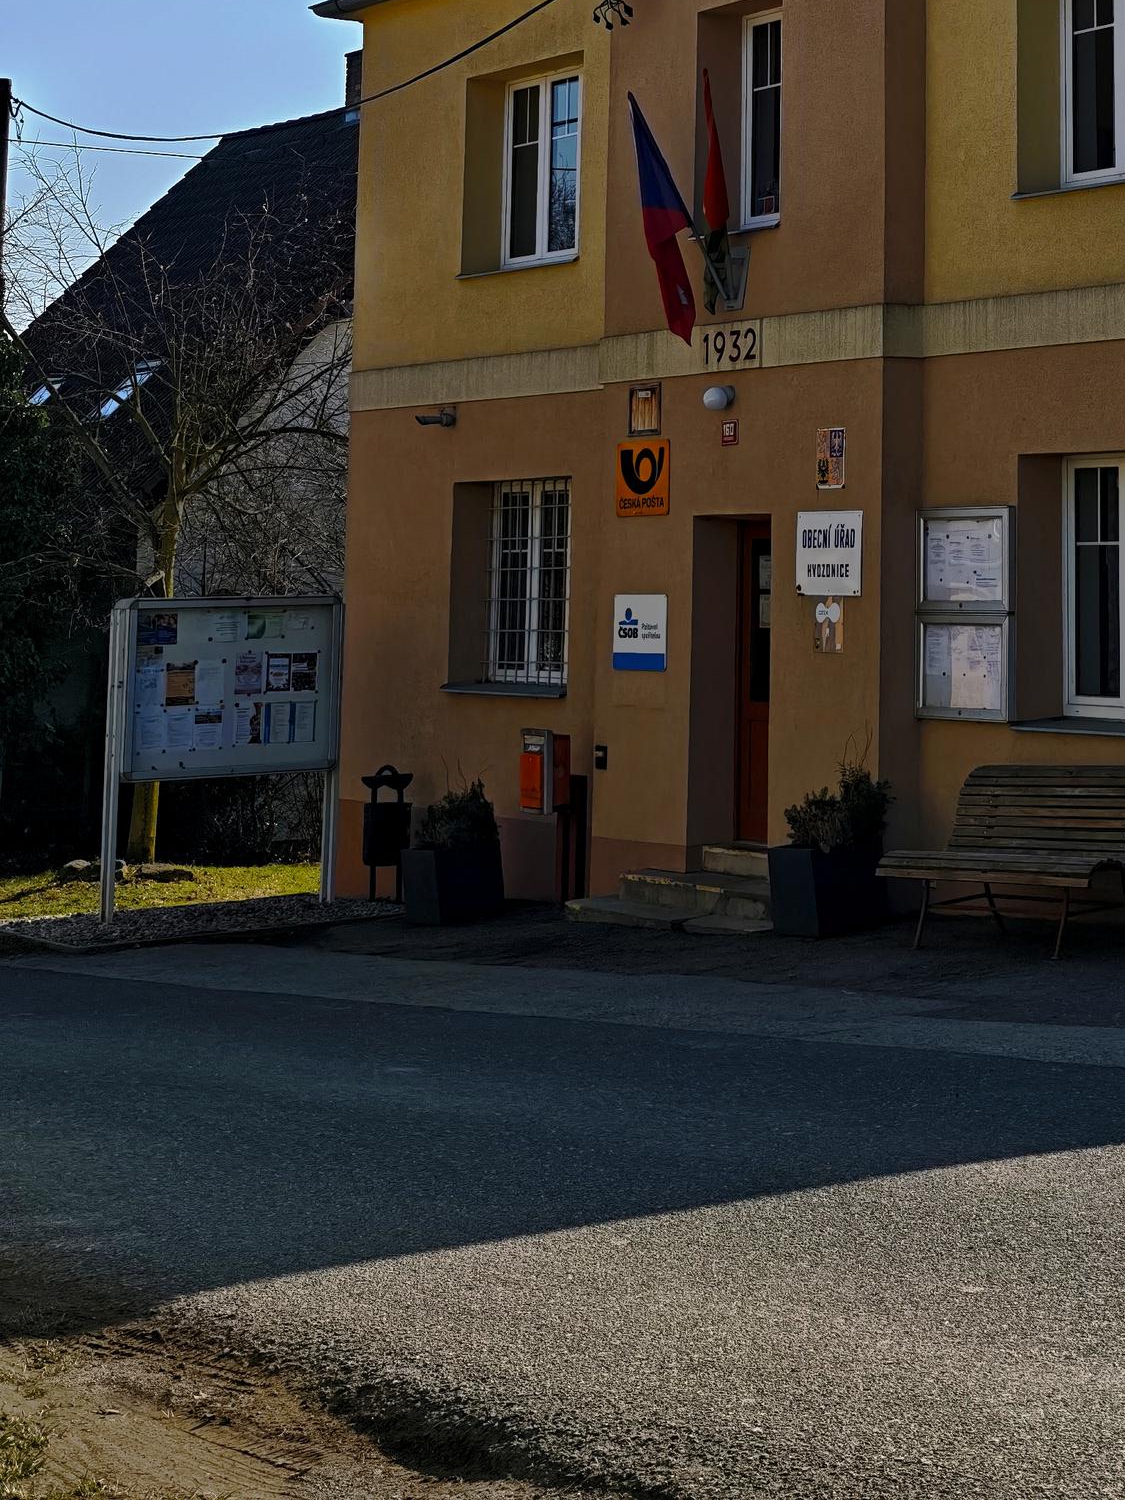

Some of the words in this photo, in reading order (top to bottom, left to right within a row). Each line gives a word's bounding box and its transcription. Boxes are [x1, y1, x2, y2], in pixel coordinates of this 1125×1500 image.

[702, 327, 757, 365] 1932
[723, 423, 735, 437] 160
[618, 496, 641, 510] ČESKÁ
[641, 494, 665, 509] POŠTA
[802, 524, 832, 549] OBECNÍ
[834, 523, 856, 549] ÚŘAD
[618, 626, 639, 639] ČSOB
